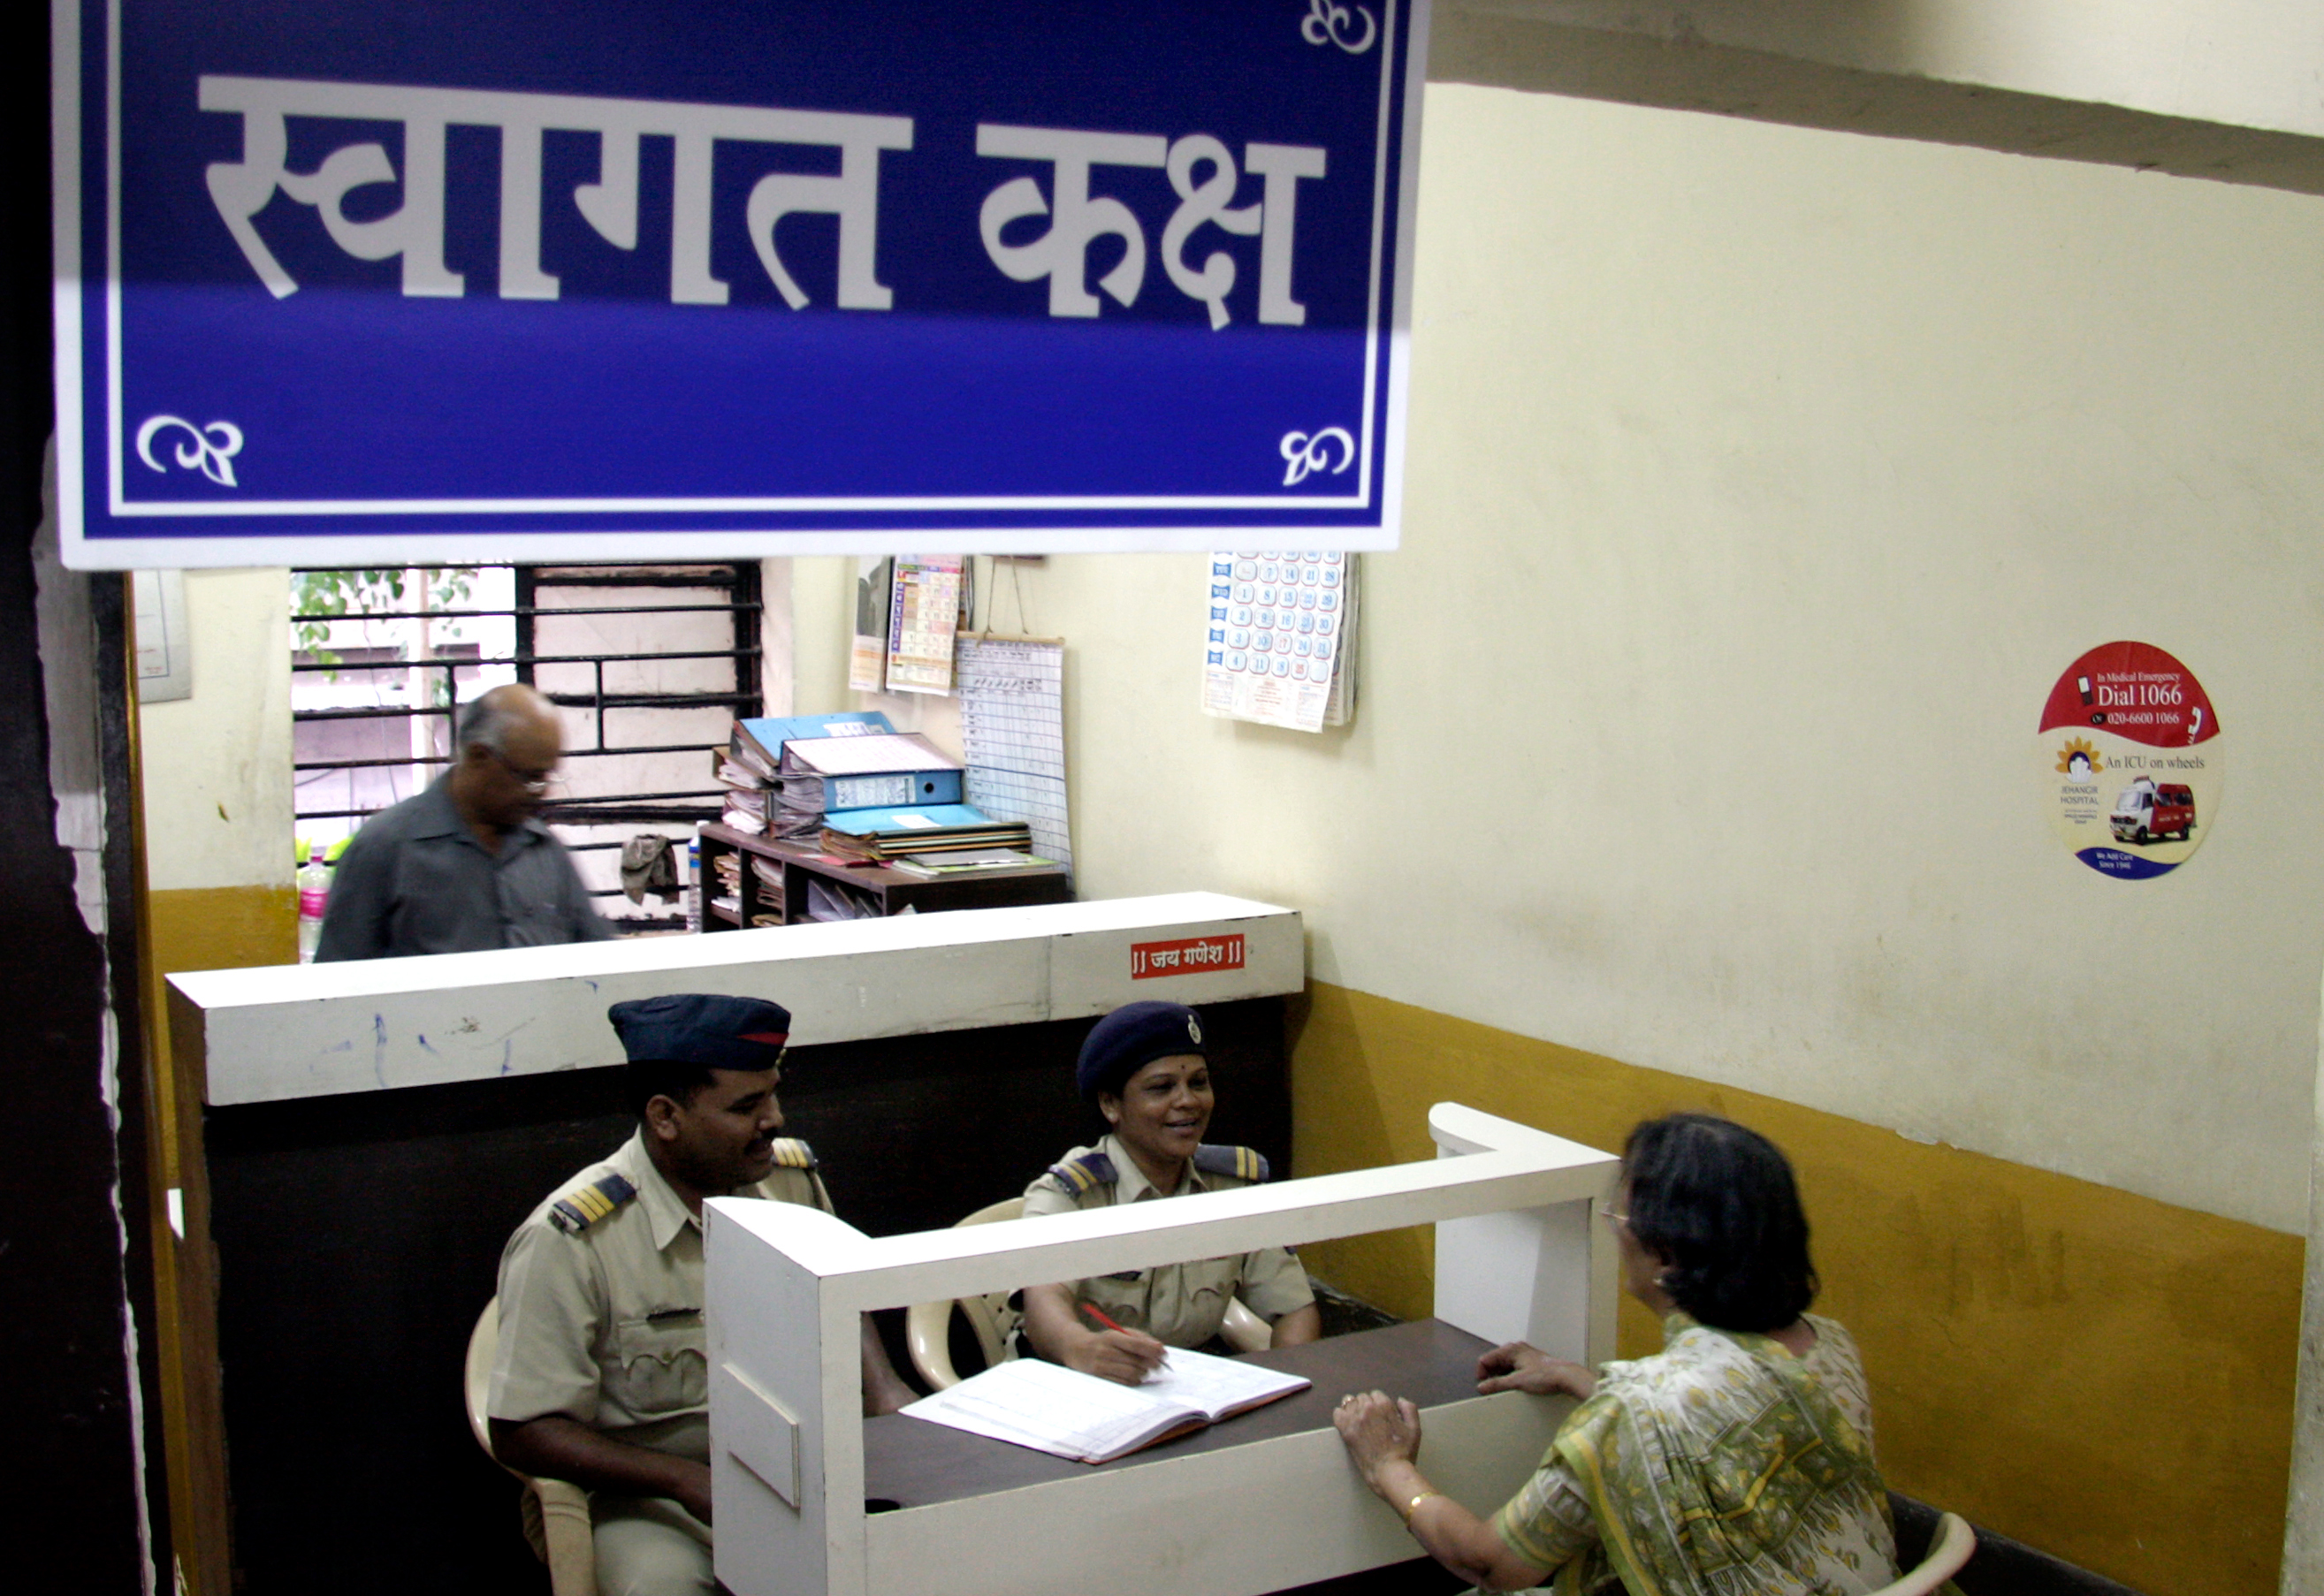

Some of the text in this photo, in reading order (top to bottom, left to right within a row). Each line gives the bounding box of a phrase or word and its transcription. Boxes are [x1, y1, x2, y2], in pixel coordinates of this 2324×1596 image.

[198, 75, 1327, 332] स्वागत कक्ष
[1267, 567, 1272, 577] 7
[1286, 569, 1294, 579] 14
[1307, 570, 1314, 581] 21
[1264, 589, 1270, 600] 8
[1284, 591, 1292, 602] 15
[1239, 611, 1245, 621] 2
[1261, 612, 1267, 623] 9
[1282, 614, 1291, 626] 16
[1235, 633, 1241, 643] 3
[1258, 636, 1266, 646] 10
[1233, 656, 1238, 666] 4
[1256, 658, 1263, 669] 11
[2097, 672, 2181, 684] In Medical Emergency
[2098, 684, 2182, 706] Dial 1066
[2107, 712, 2153, 725] 020-6600
[2155, 712, 2180, 725] 1066
[2106, 756, 2206, 769] An ICU on wheels
[2061, 786, 2099, 794] JEHANGIR
[2061, 796, 2099, 805] HOSPITAL
[2098, 860, 2114, 869] Since
[1151, 949, 1180, 968] जय
[1184, 941, 1223, 965] गणेश
